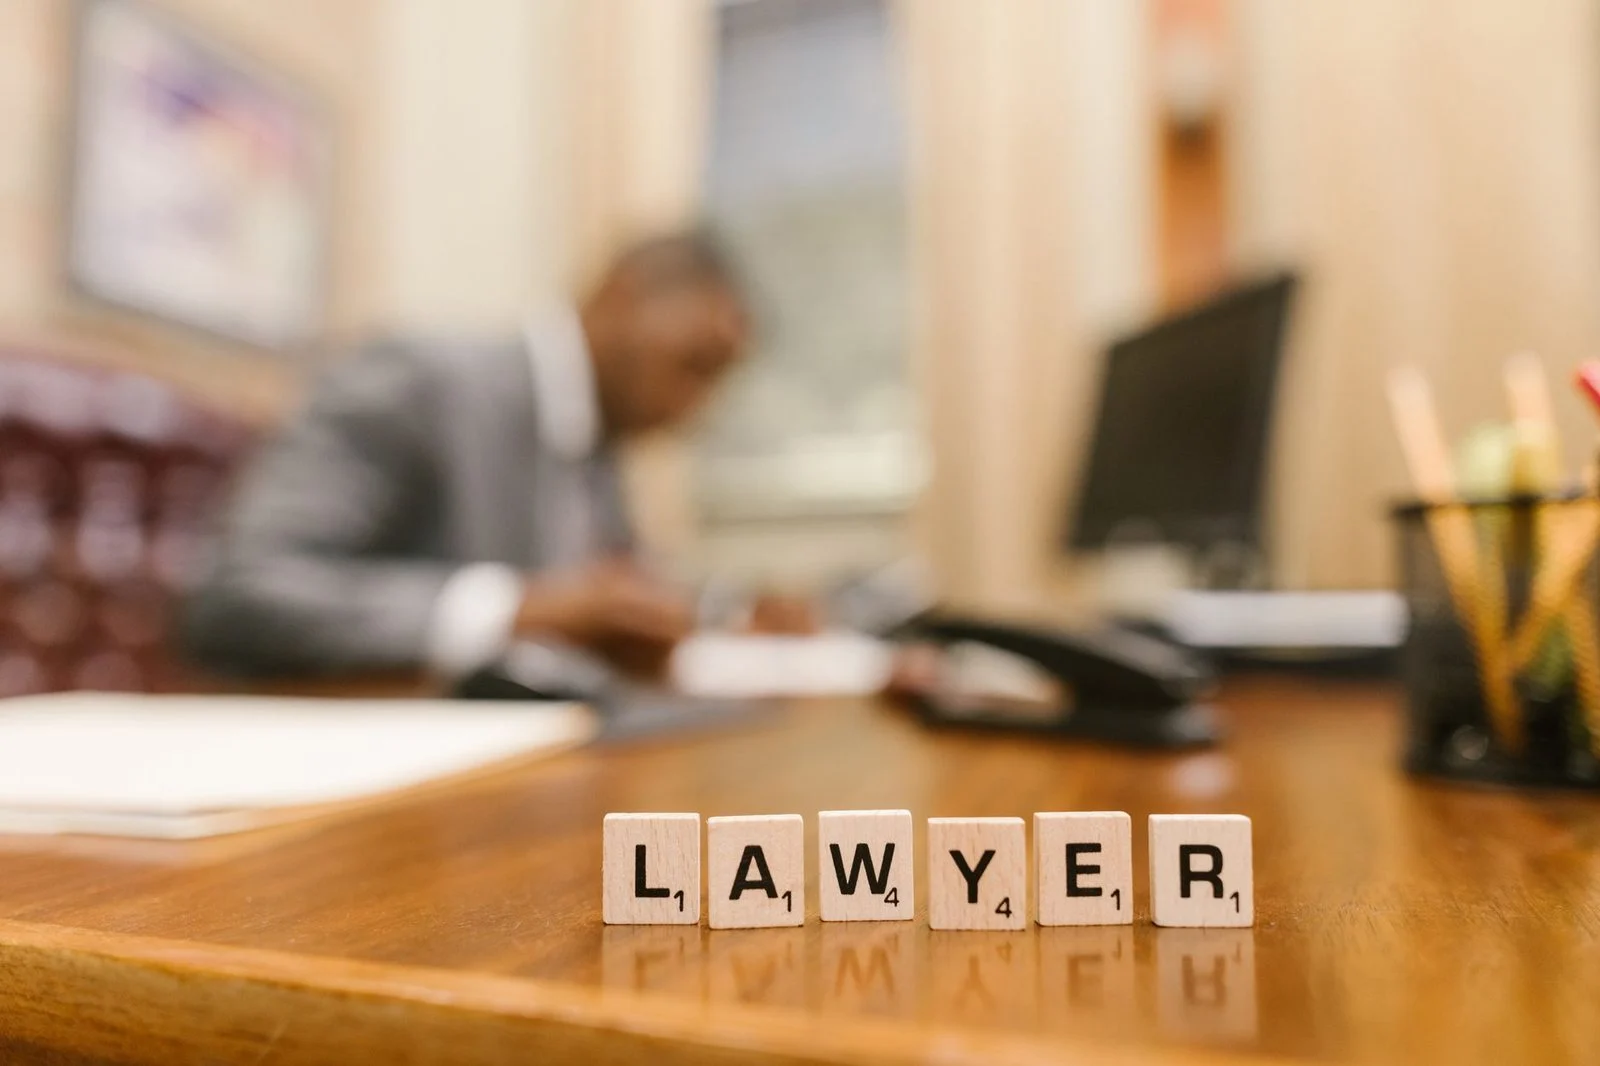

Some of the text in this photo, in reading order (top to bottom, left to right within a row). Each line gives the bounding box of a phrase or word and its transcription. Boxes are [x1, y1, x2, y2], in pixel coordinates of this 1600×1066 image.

[635, 844, 685, 913] L 1
[729, 845, 792, 913] A 1
[829, 843, 900, 907] W 4
[949, 849, 1013, 919] Y 4
[1066, 842, 1121, 911] E 1
[1179, 844, 1241, 913] R 1
